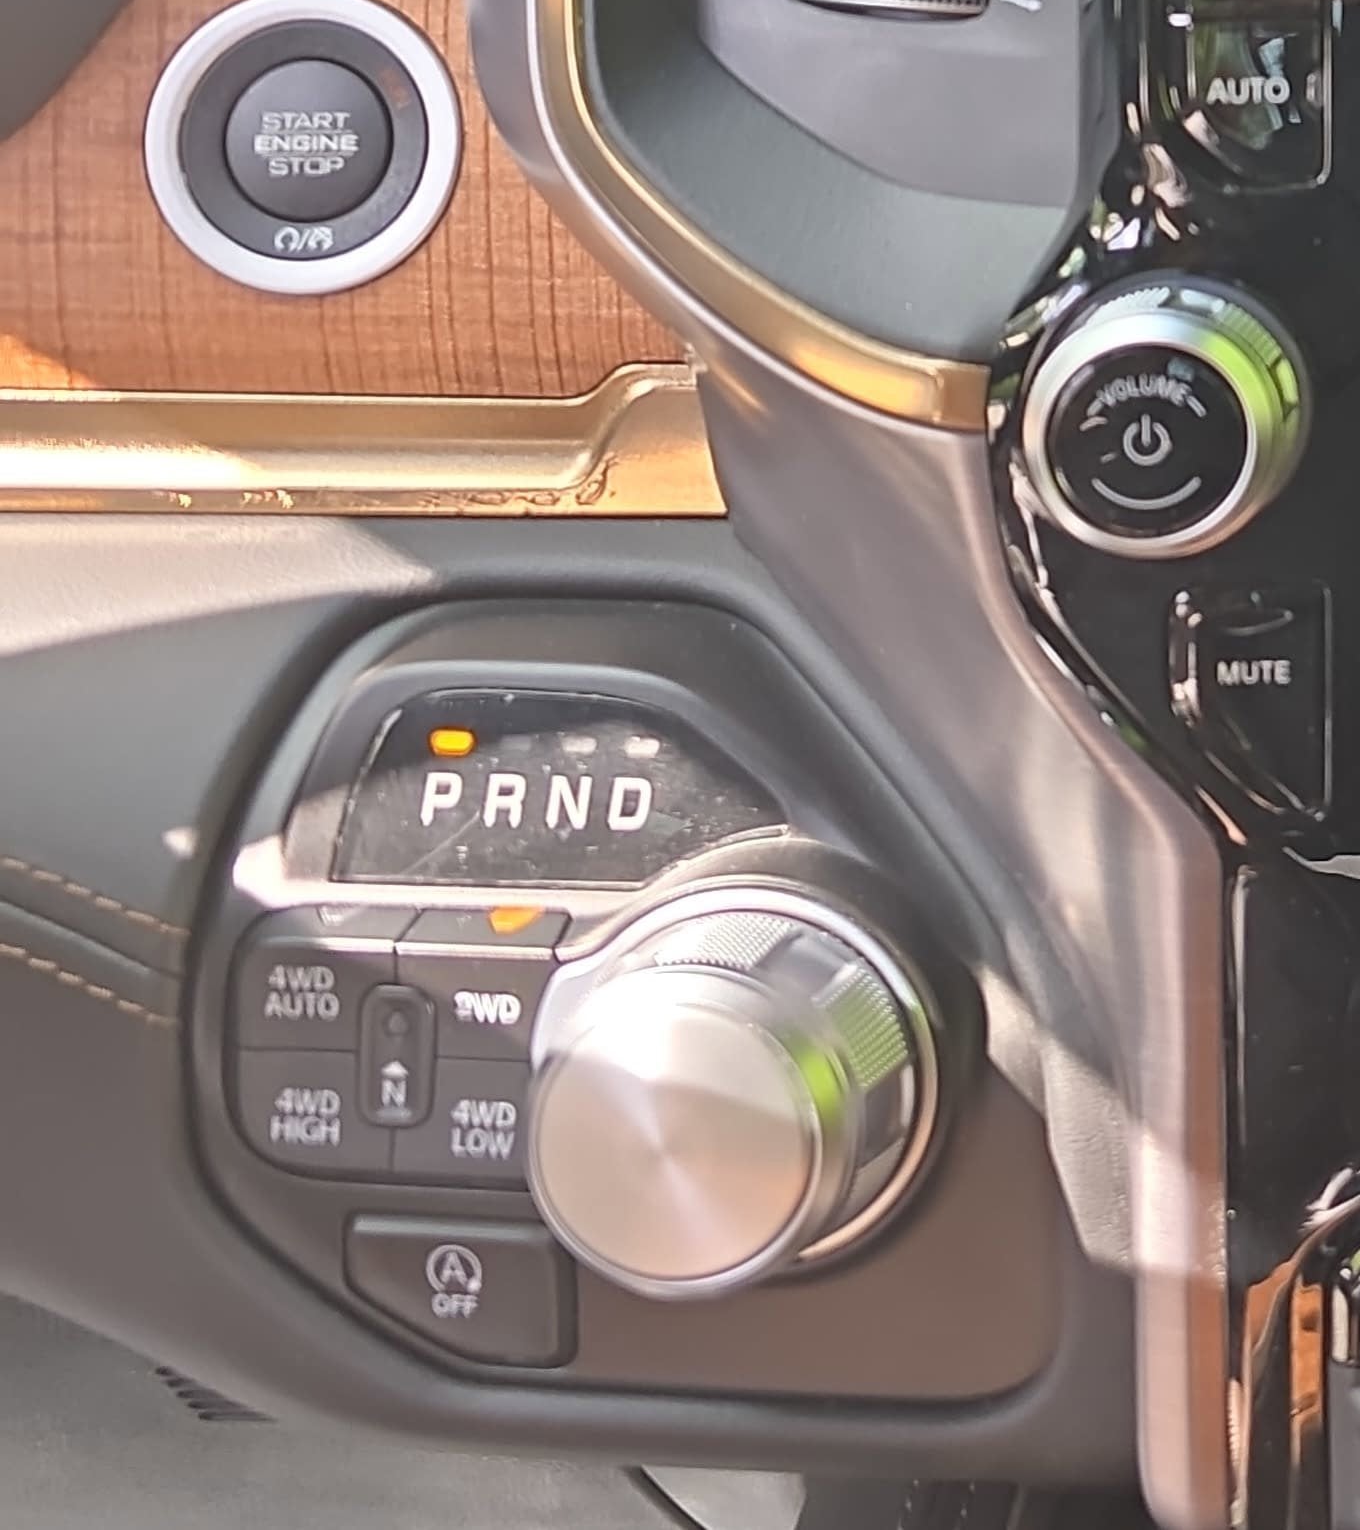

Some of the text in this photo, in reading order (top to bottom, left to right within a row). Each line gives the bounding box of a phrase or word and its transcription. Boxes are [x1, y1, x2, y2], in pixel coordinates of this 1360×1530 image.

[1206, 75, 1291, 105] AUTO
[261, 111, 350, 132] START
[254, 134, 359, 154] ENGINE
[268, 156, 345, 176] STOP
[1097, 373, 1192, 409] VOLUME
[1217, 659, 1292, 686] MUTE
[267, 965, 335, 990] 4WD
[264, 992, 340, 1020] AUTO
[274, 1087, 341, 1116] 4WD
[381, 1079, 407, 1108] N
[450, 1099, 517, 1129] 4WD
[270, 1116, 341, 1147] HIGH
[451, 1129, 515, 1160] LOW
[430, 1293, 479, 1318] OFF
